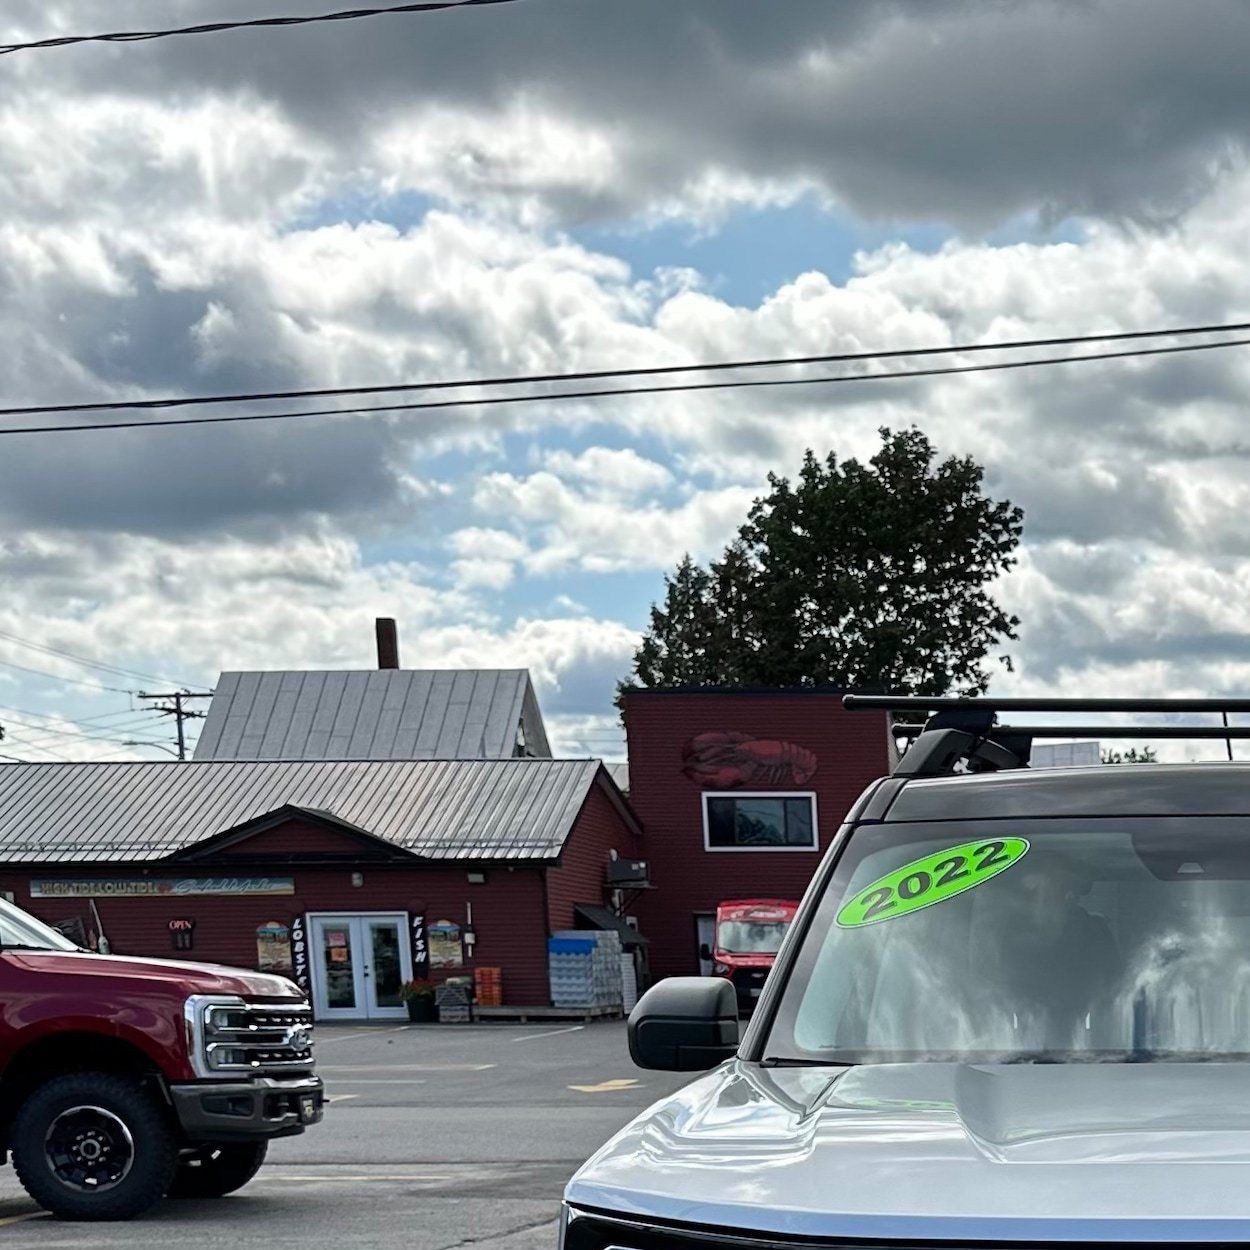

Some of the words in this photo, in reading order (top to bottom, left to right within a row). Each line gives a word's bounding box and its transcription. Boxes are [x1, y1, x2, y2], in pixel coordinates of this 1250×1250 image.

[860, 841, 1012, 921] 2022
[169, 919, 192, 930] OPEN
[413, 916, 427, 963] FISH
